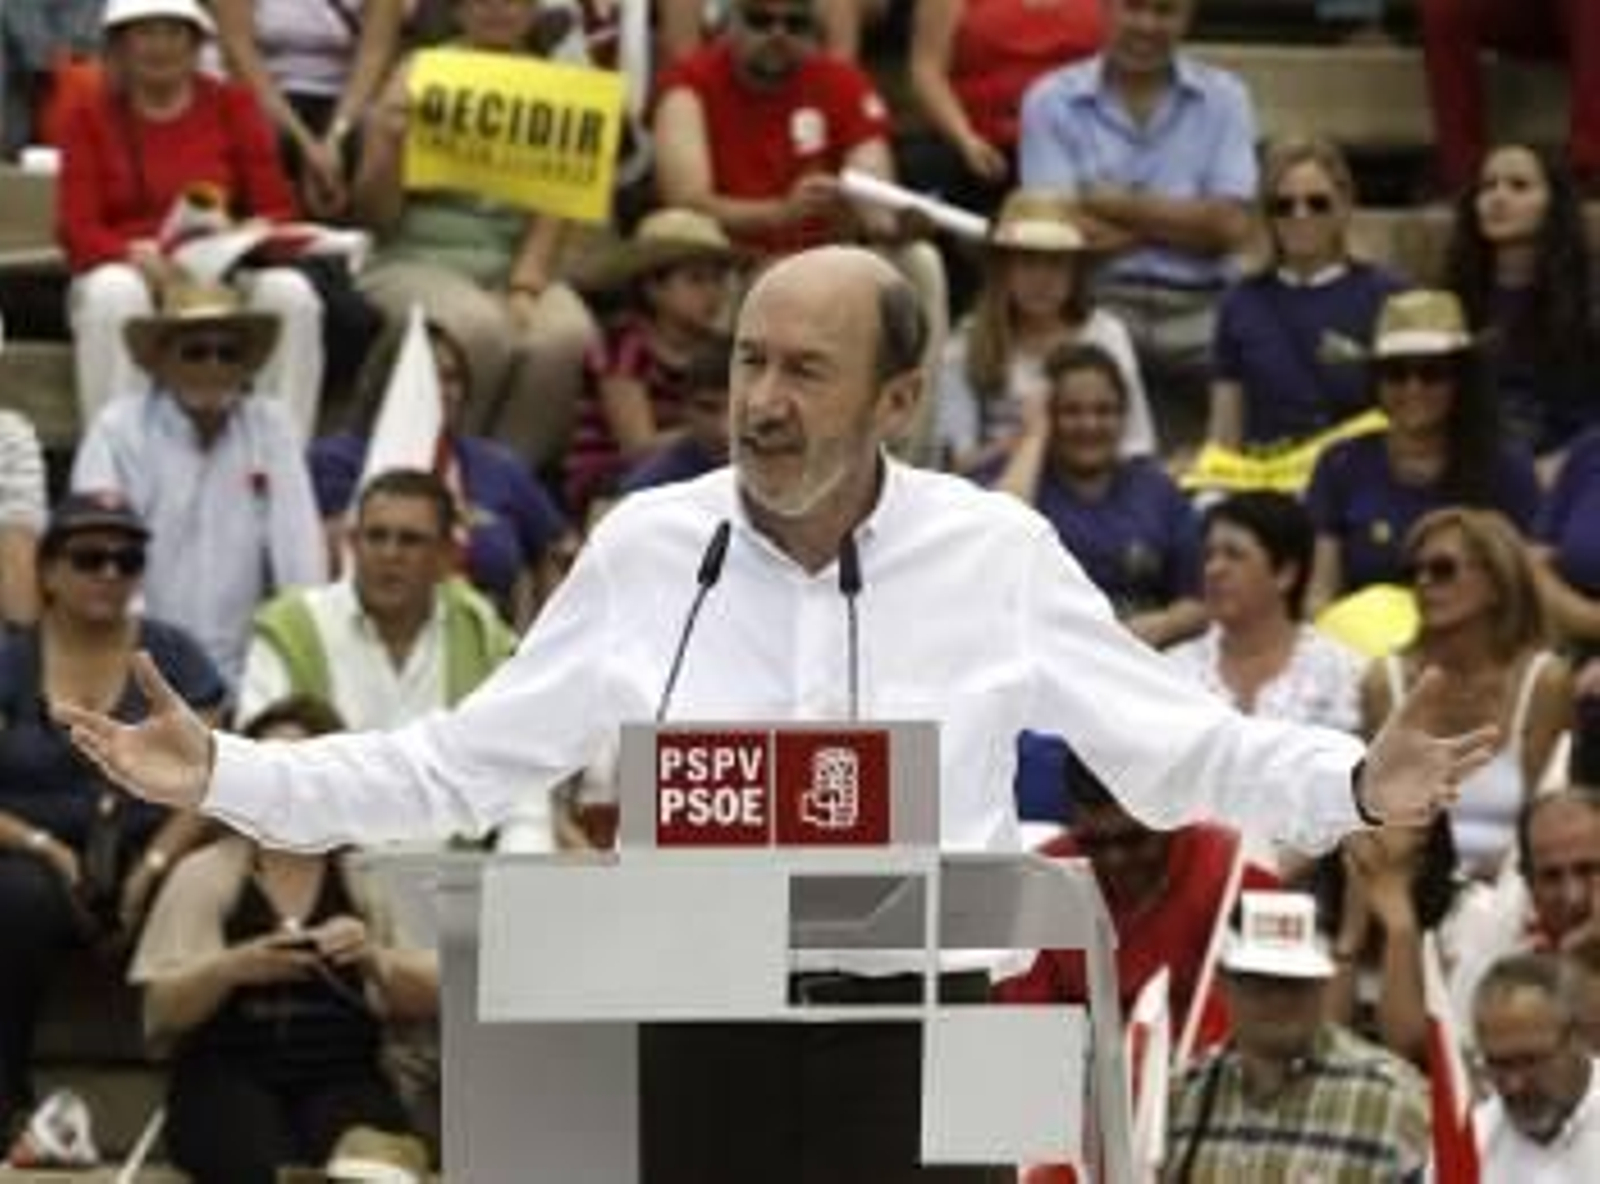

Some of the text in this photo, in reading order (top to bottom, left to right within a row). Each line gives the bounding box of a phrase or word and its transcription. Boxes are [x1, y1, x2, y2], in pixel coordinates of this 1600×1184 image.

[420, 83, 605, 154] DECIDIR
[659, 746, 763, 782] PSPV
[659, 787, 764, 826] PSOE
